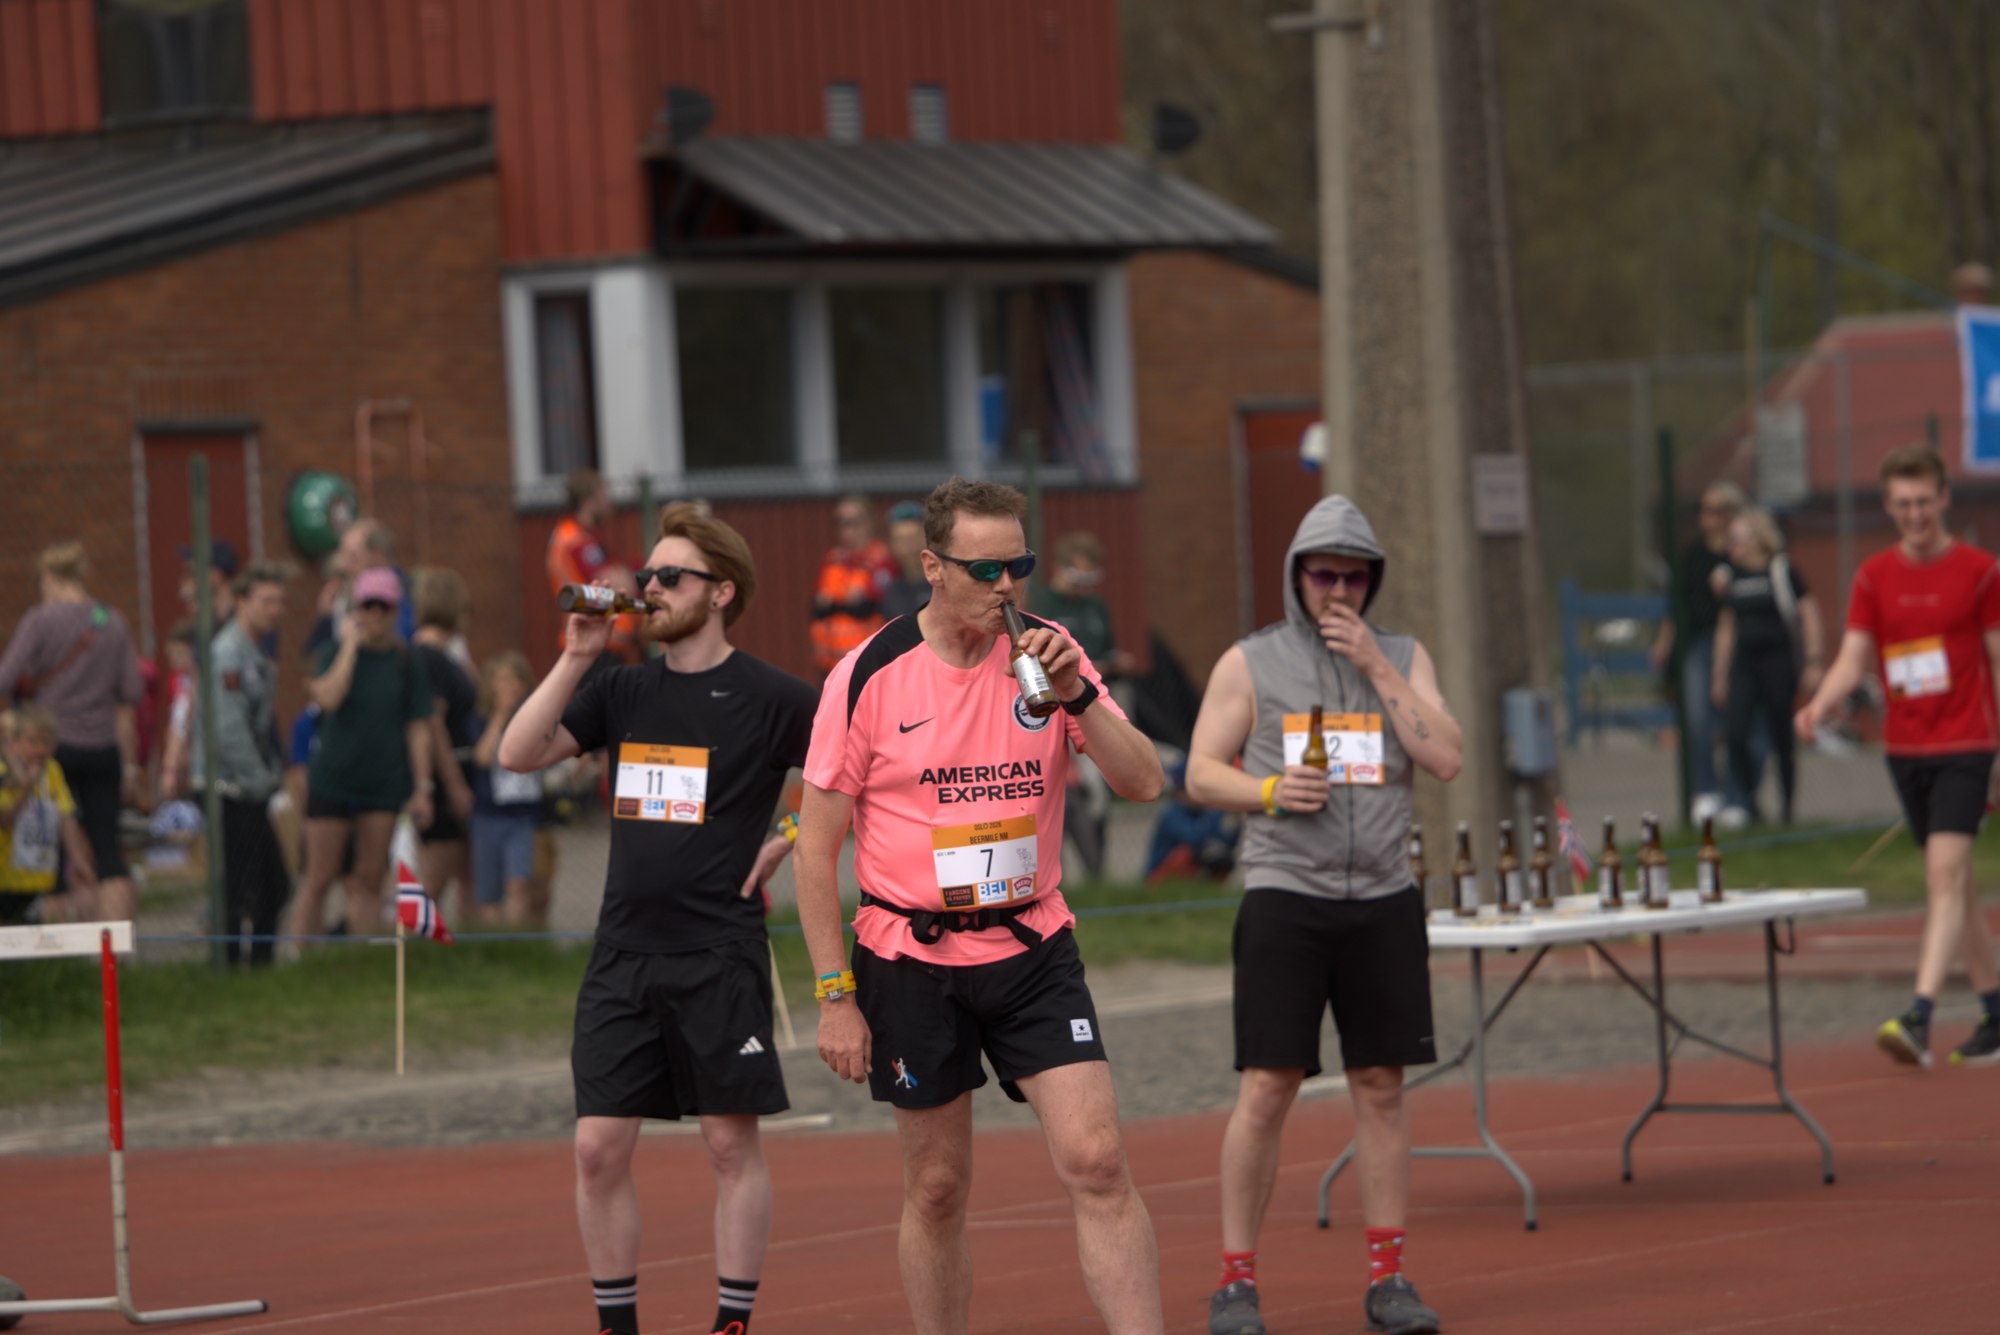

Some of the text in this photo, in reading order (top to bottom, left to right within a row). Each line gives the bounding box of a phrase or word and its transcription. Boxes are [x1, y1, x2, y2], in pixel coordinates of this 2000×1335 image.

[647, 769, 663, 795] 11
[919, 760, 1042, 785] AMERICAN
[938, 780, 1044, 804] EXPRESS
[969, 833, 999, 845] BEERMILE
[980, 848, 993, 878] 7
